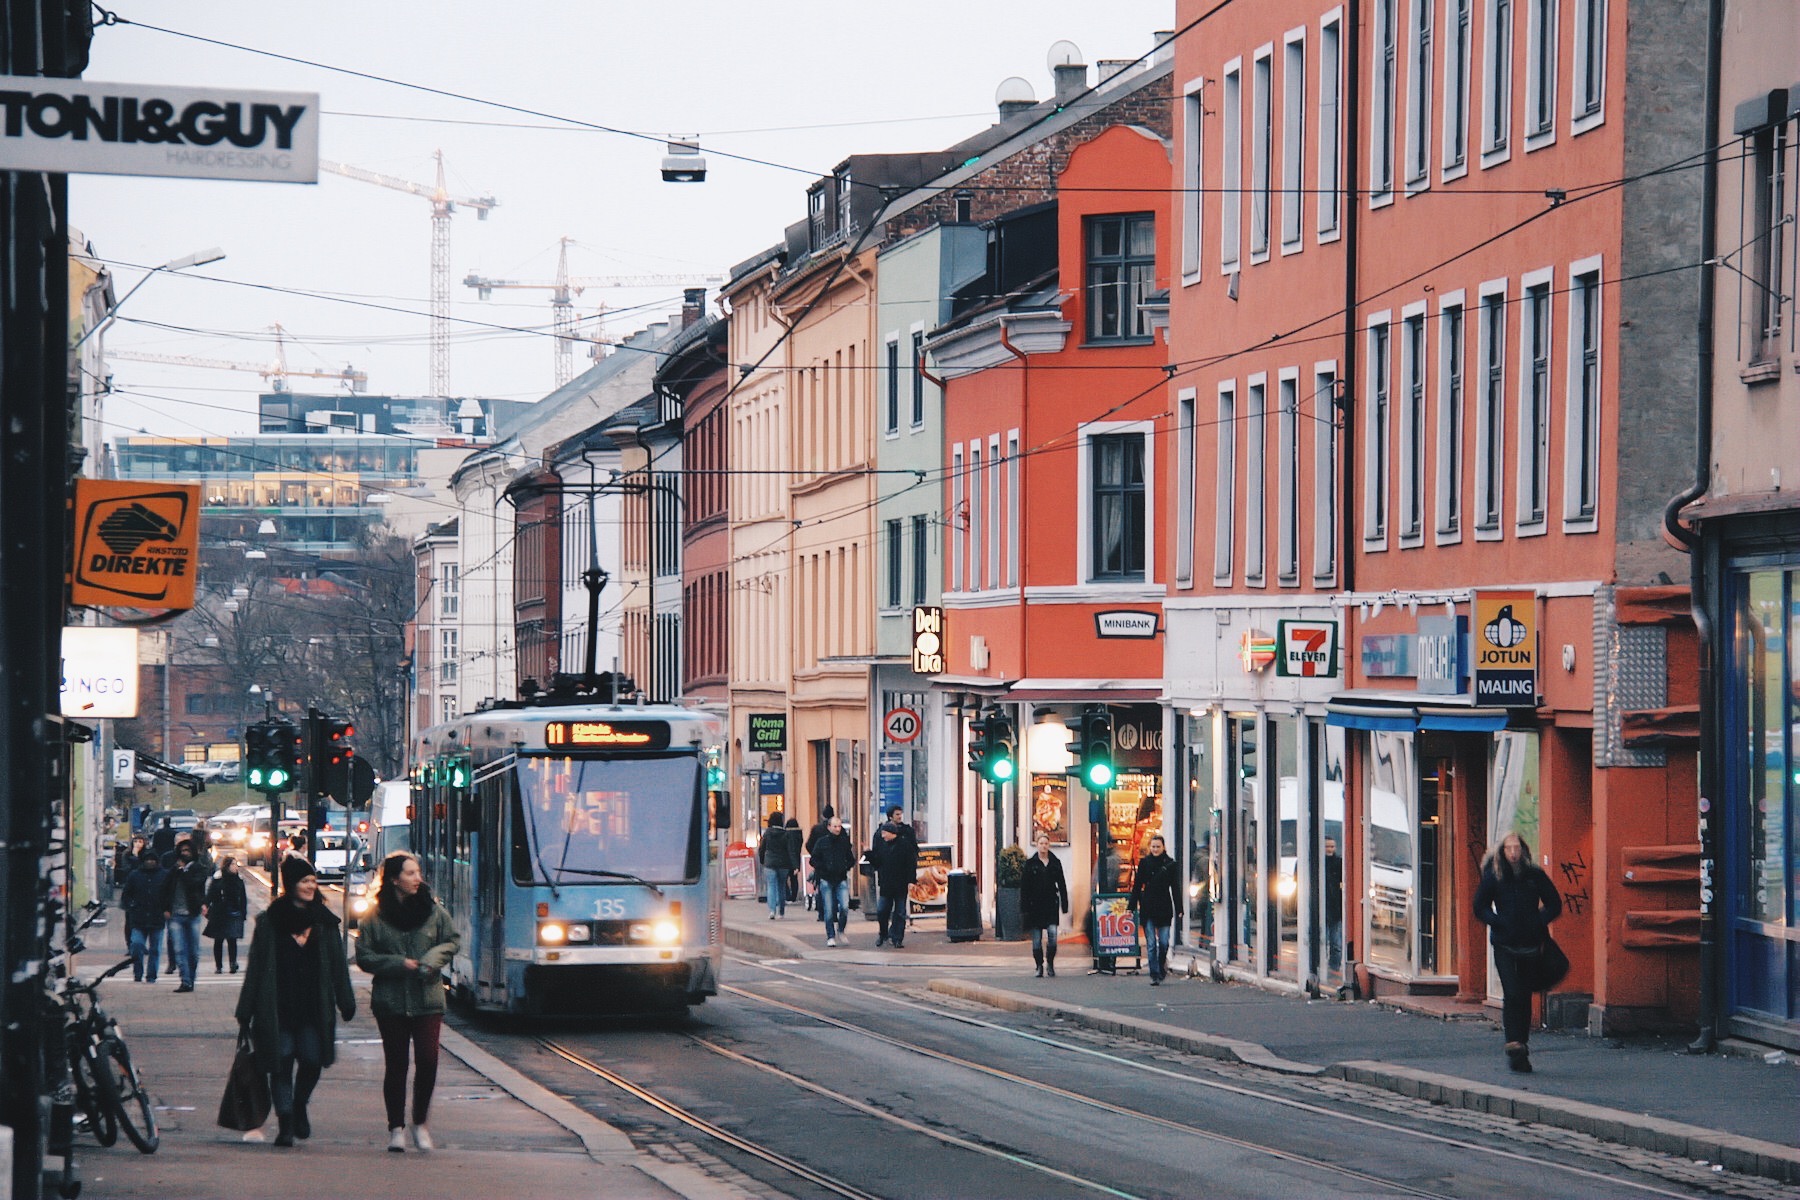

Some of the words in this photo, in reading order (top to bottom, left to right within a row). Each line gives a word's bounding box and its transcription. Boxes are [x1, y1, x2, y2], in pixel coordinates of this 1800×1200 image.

[0, 90, 306, 150] TONI&GUY
[166, 149, 292, 169] HAIRDRESSING
[90, 554, 187, 577] DIREKTE
[915, 607, 940, 633] Deli
[1104, 619, 1151, 629] MINIBANK
[914, 647, 942, 673] Luca
[1291, 628, 1327, 677] 7
[1480, 650, 1531, 664] JOTUN
[1478, 679, 1533, 695] MALING
[752, 717, 785, 729] Noma
[889, 717, 915, 734] 40
[547, 723, 564, 744] 11
[756, 729, 781, 741] Grill
[118, 758, 129, 774] P
[594, 898, 625, 919] 135
[1098, 912, 1136, 937] 116
